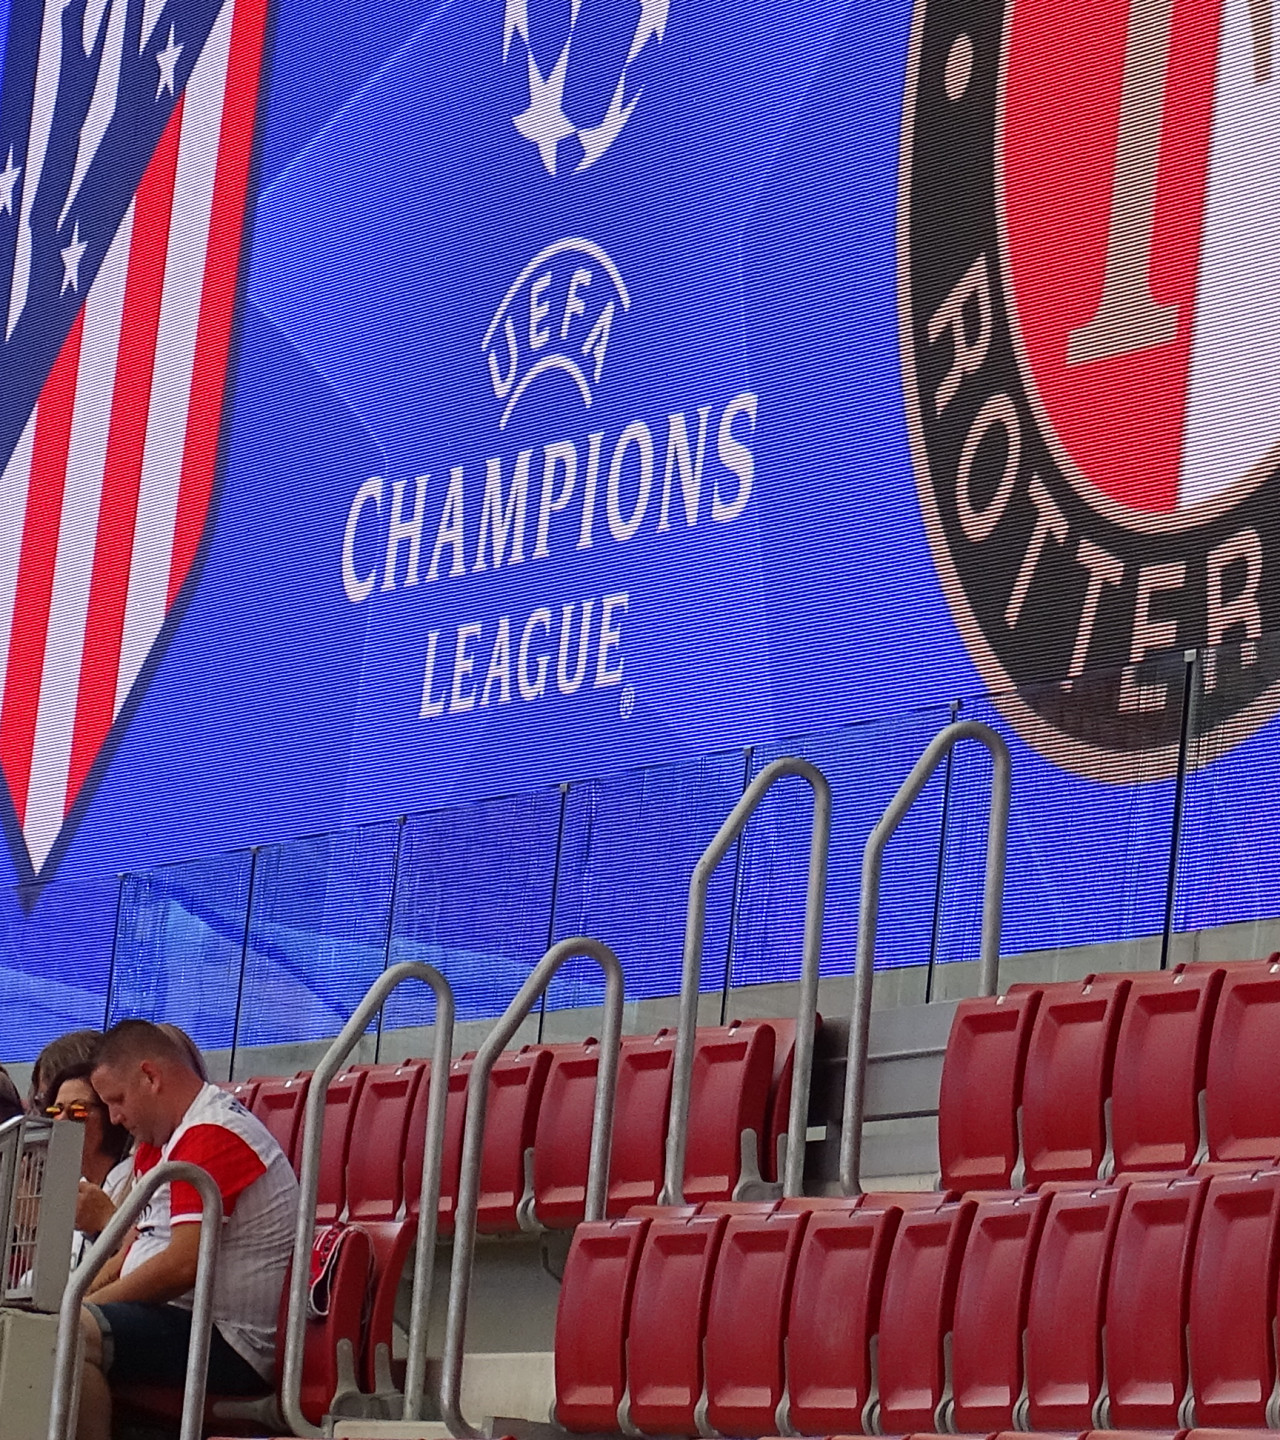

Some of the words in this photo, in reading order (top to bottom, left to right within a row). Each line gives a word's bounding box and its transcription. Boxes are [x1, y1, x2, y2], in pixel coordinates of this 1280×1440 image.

[488, 269, 614, 398] UEFA
[342, 393, 759, 603] CHAMPIONS
[418, 594, 629, 718] LEAGUE
